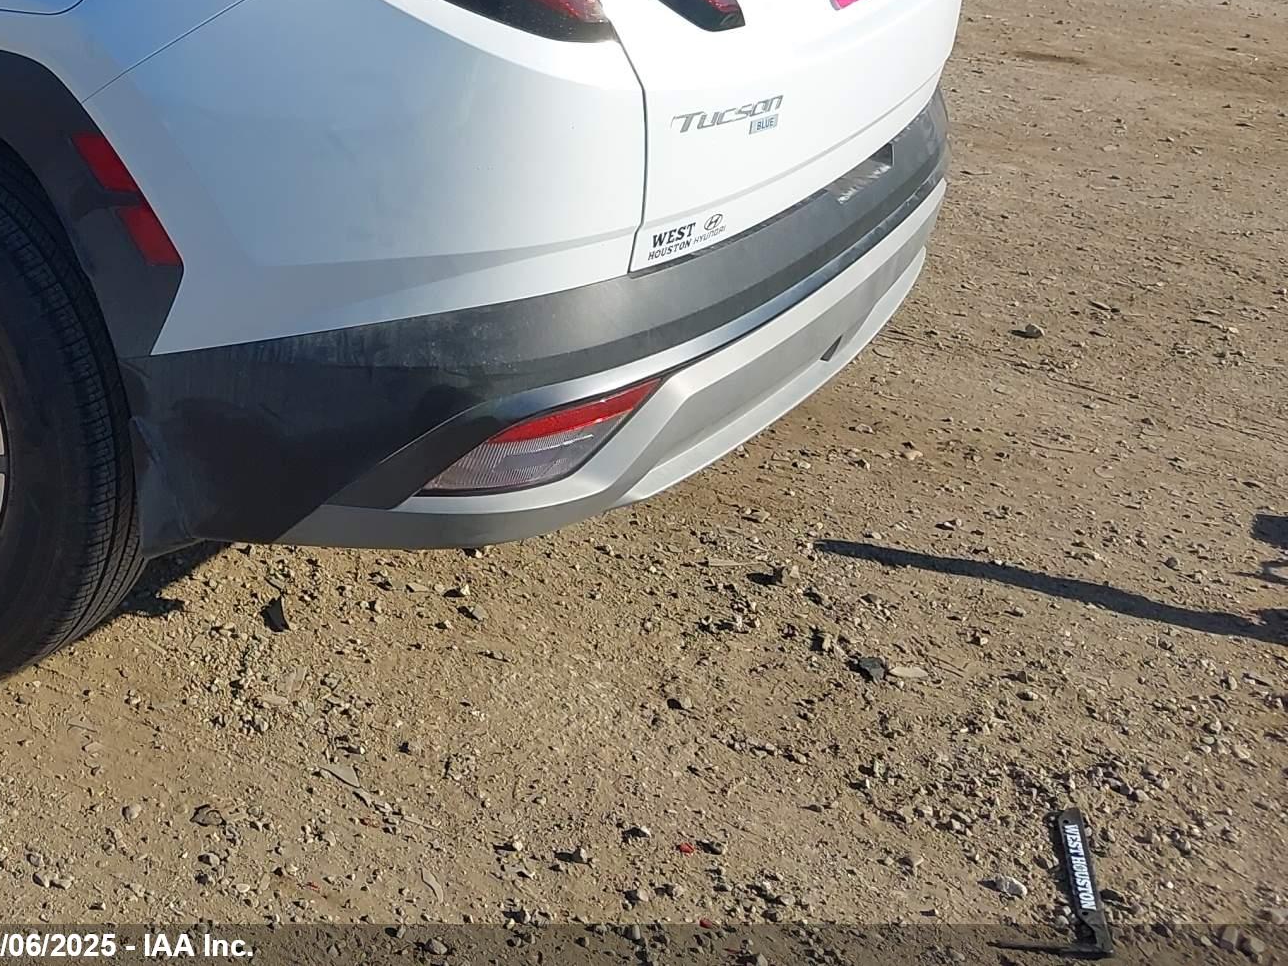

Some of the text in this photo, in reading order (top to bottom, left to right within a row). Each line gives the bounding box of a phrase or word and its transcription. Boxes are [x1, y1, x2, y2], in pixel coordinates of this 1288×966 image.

[756, 116, 775, 132] BLUE
[648, 225, 727, 261] HOUSTON HYUNDAI
[653, 222, 696, 248] WEST
[1064, 824, 1097, 911] WEST HOUSTON
